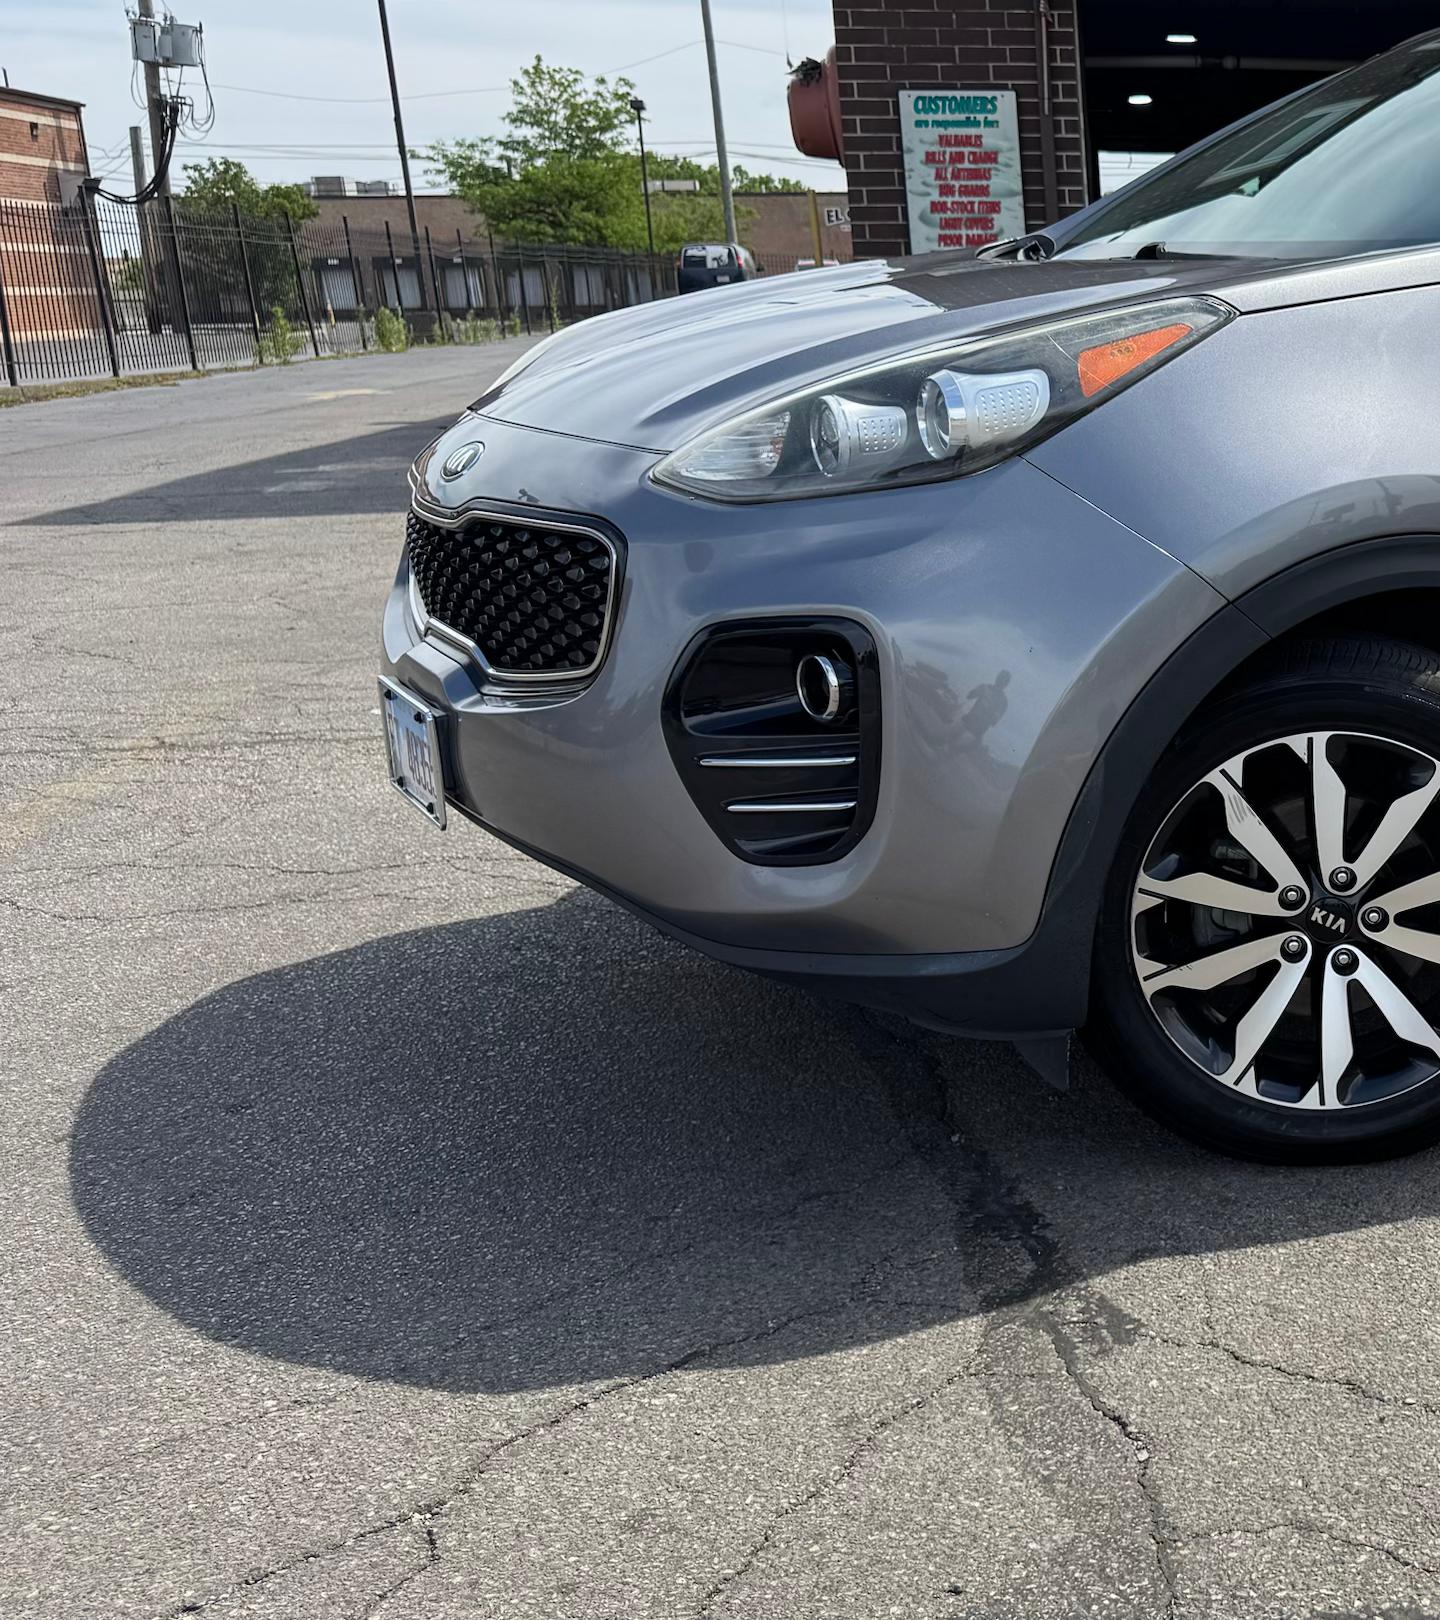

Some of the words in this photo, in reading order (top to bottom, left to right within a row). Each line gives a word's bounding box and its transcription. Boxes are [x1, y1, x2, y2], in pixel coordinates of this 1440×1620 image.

[914, 96, 998, 115] CUSTOMERS
[931, 116, 981, 131] responsible
[938, 135, 983, 148] VALUABLES
[948, 150, 965, 165] AND
[967, 150, 999, 165] CHANGE
[934, 168, 949, 182] ALL
[1310, 907, 1346, 934] KIA
